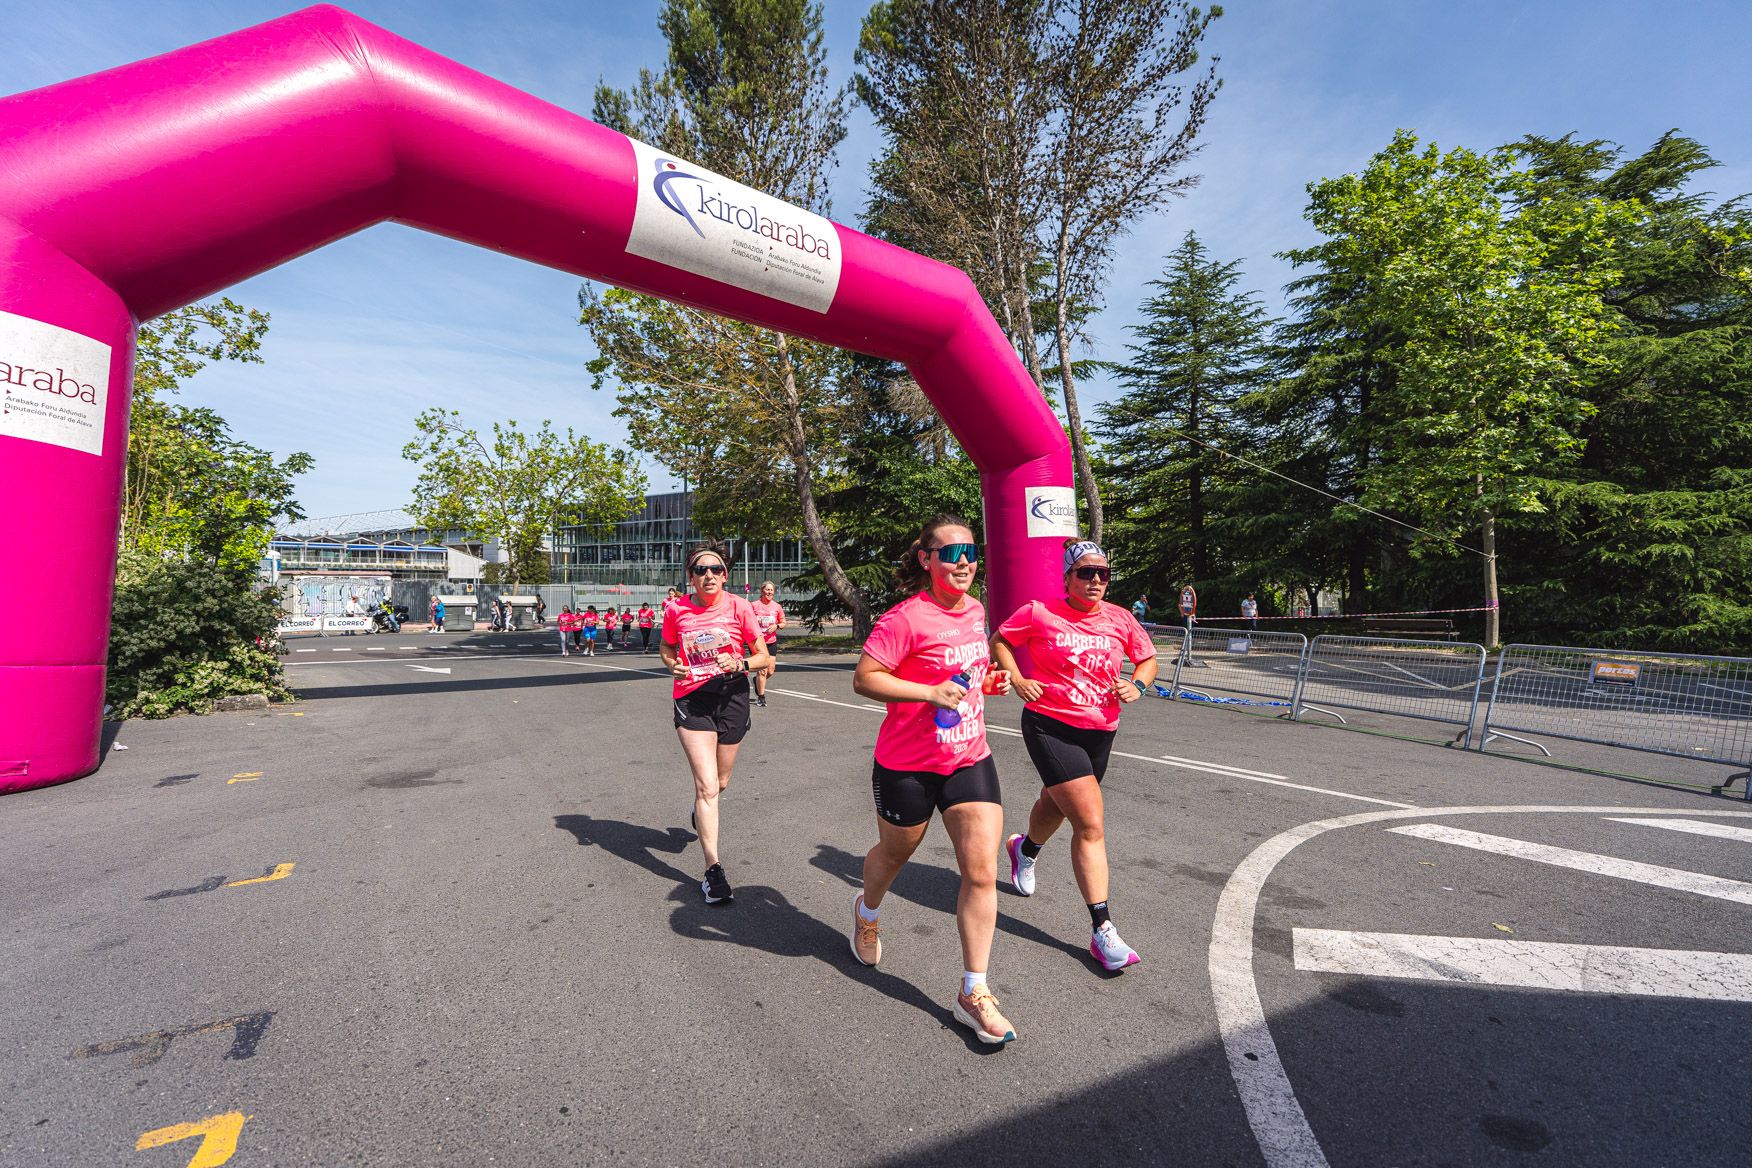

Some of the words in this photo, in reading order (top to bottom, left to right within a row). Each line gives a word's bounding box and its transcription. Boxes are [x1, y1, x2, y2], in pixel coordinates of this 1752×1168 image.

[696, 184, 831, 260] kirolaraba
[732, 239, 764, 255] FUNDAZIOA
[768, 252, 789, 264] Arabako
[789, 259, 801, 268] Foru
[801, 263, 822, 275] Aldundia
[793, 268, 805, 277] Foral
[4, 402, 47, 416] Diputación
[49, 412, 66, 421] Foral
[67, 416, 76, 424] de
[5, 395, 39, 407] Arabako
[41, 402, 57, 412] Foru
[59, 407, 87, 419] Aldundia
[290, 620, 315, 628] CORREO
[936, 628, 960, 640] OYSHO
[936, 719, 979, 744] MUJER
